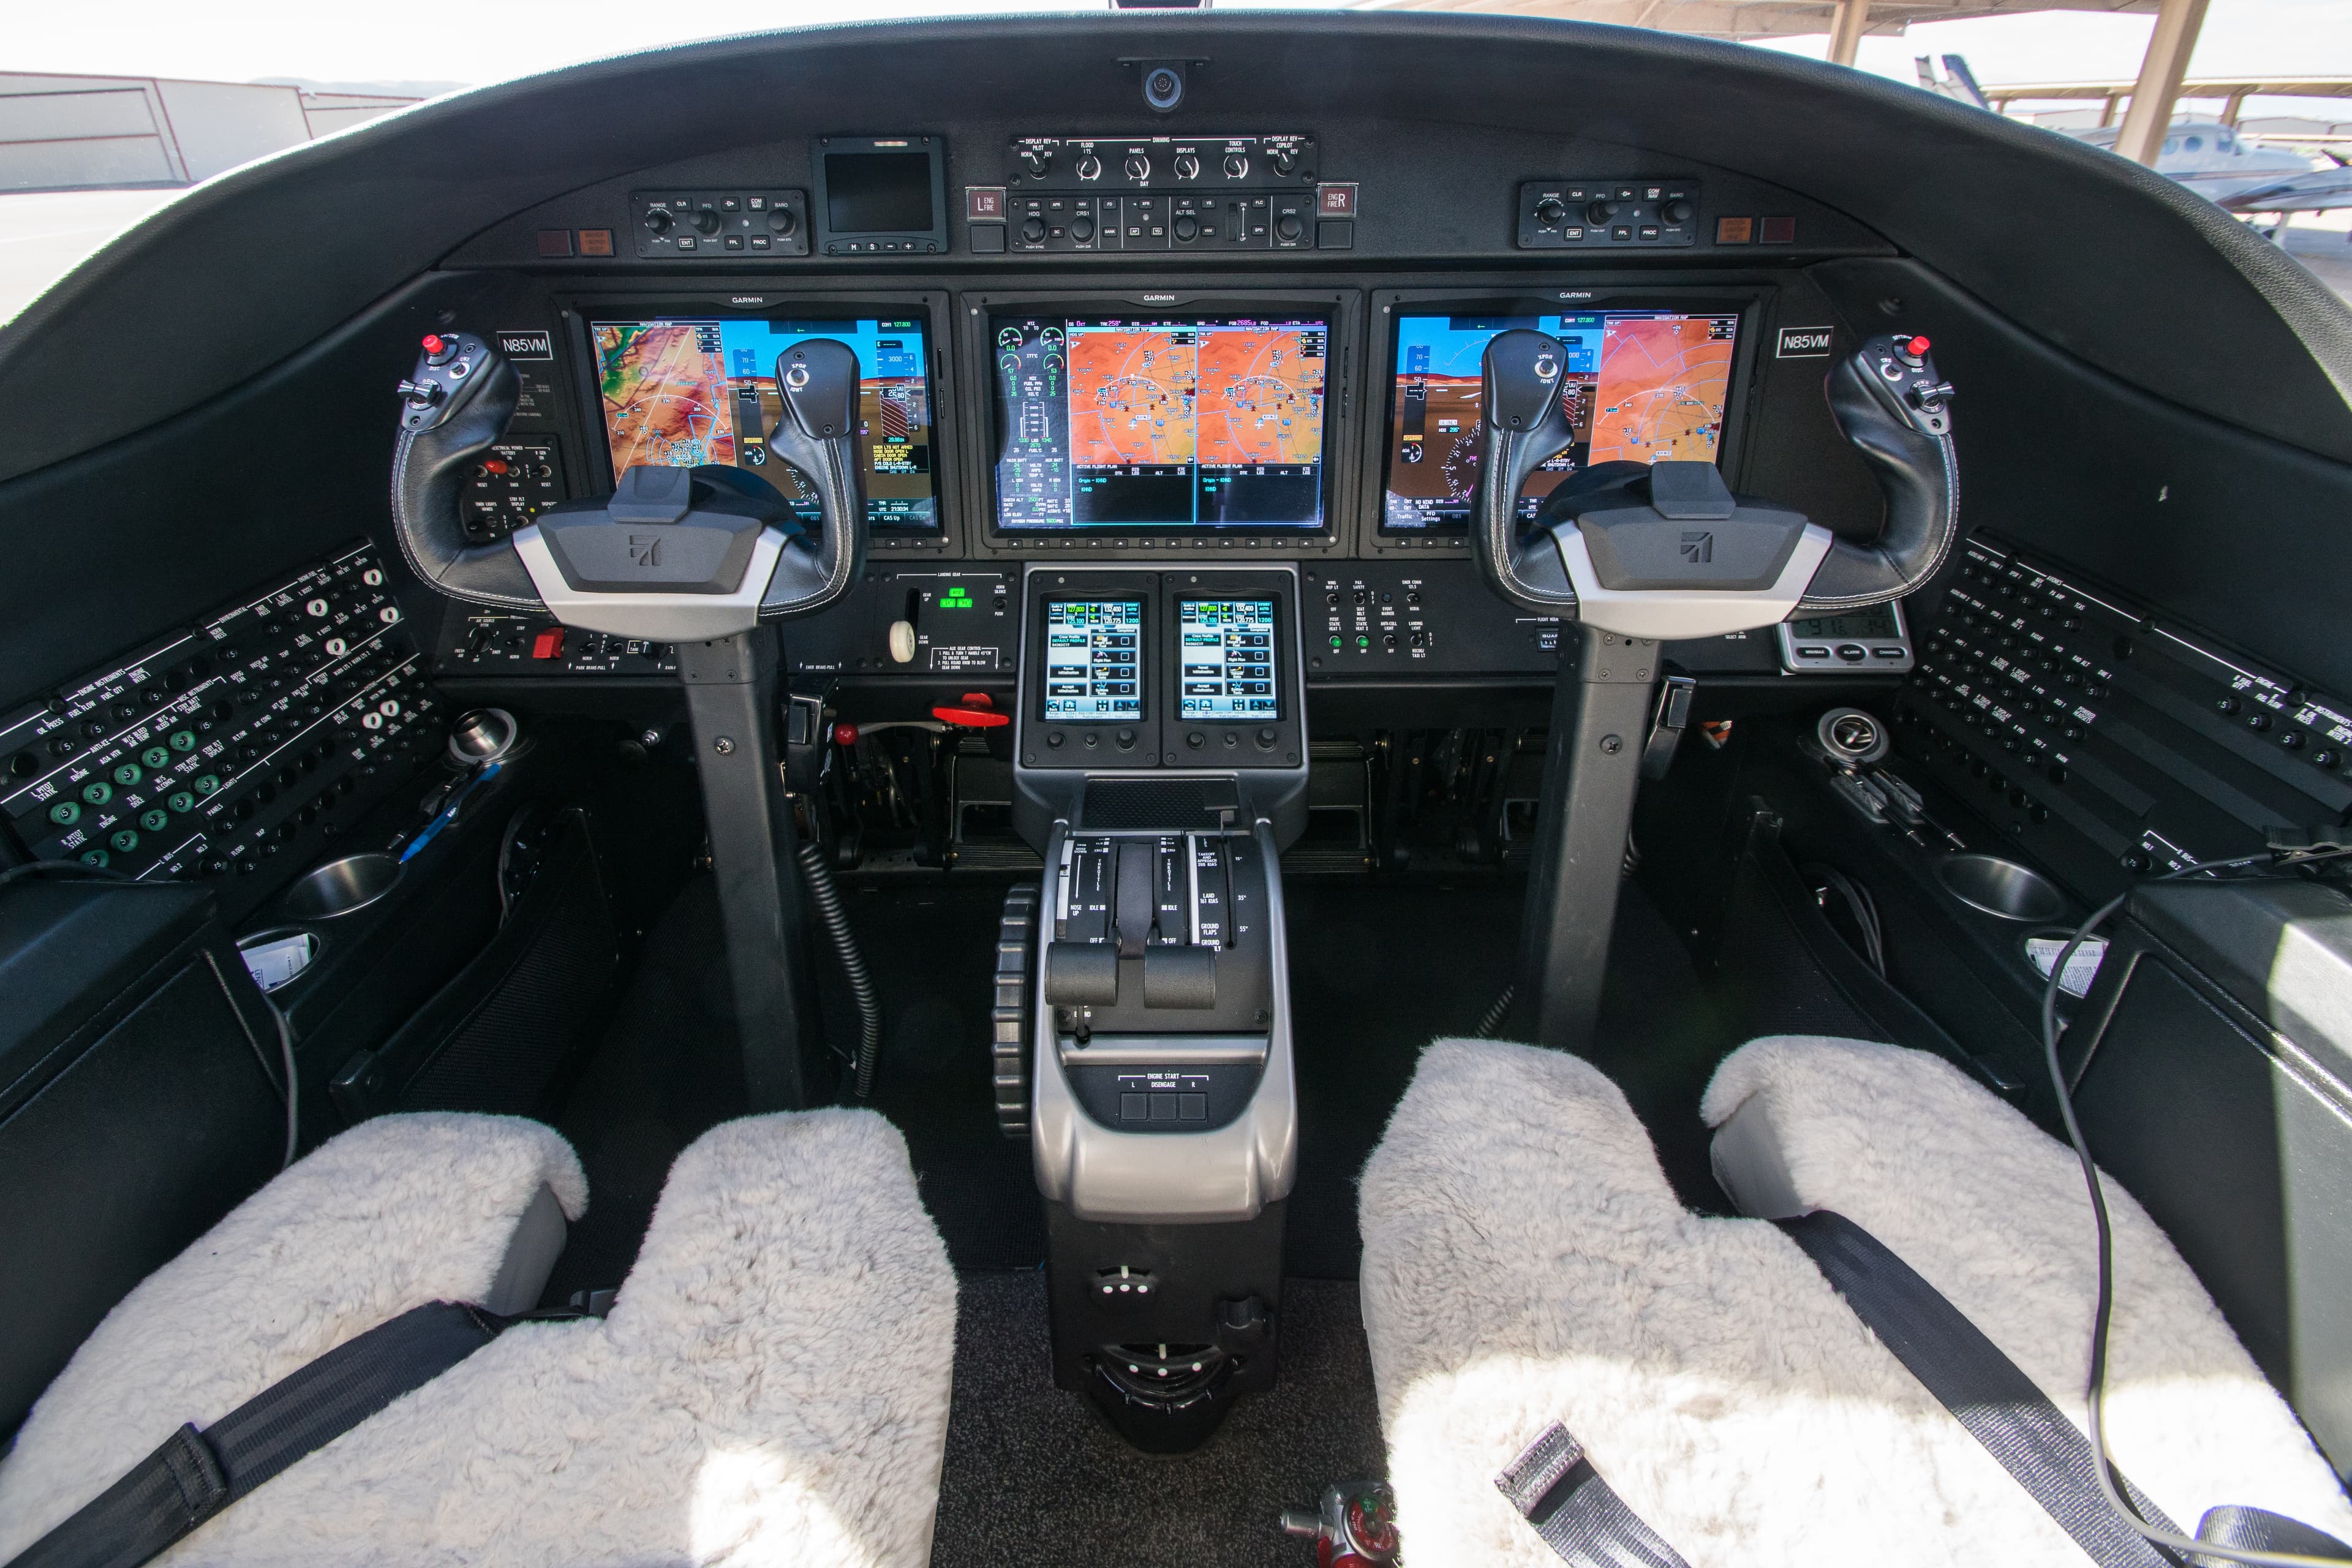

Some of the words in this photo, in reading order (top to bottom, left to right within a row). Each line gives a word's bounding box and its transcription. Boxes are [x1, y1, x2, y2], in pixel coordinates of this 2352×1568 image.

[1338, 194, 1345, 207] R
[503, 339, 547, 352] N85VM
[1784, 334, 1829, 349] N85VM
[219, 607, 248, 623] ENVIRONMENTAL
[78, 684, 94, 696] ENGINE
[94, 669, 126, 687] INSTRUMENTS
[69, 708, 81, 718] FUEL
[82, 701, 96, 711] FLOW
[48, 718, 64, 729] PRESS
[90, 739, 110, 753] ANTI-ICE
[99, 755, 110, 764] AOA
[111, 750, 122, 758] HTR
[70, 768, 89, 782] ENGINE
[36, 782, 53, 794] PITOT
[224, 778, 238, 789] LIGHTS
[39, 788, 58, 801] STATIC
[130, 798, 145, 808] DEICE
[207, 804, 223, 816] PANELS
[100, 815, 117, 828] ENGINE
[67, 829, 83, 842] PITOT
[69, 835, 87, 849] STATIC
[231, 845, 245, 856] FLOOD
